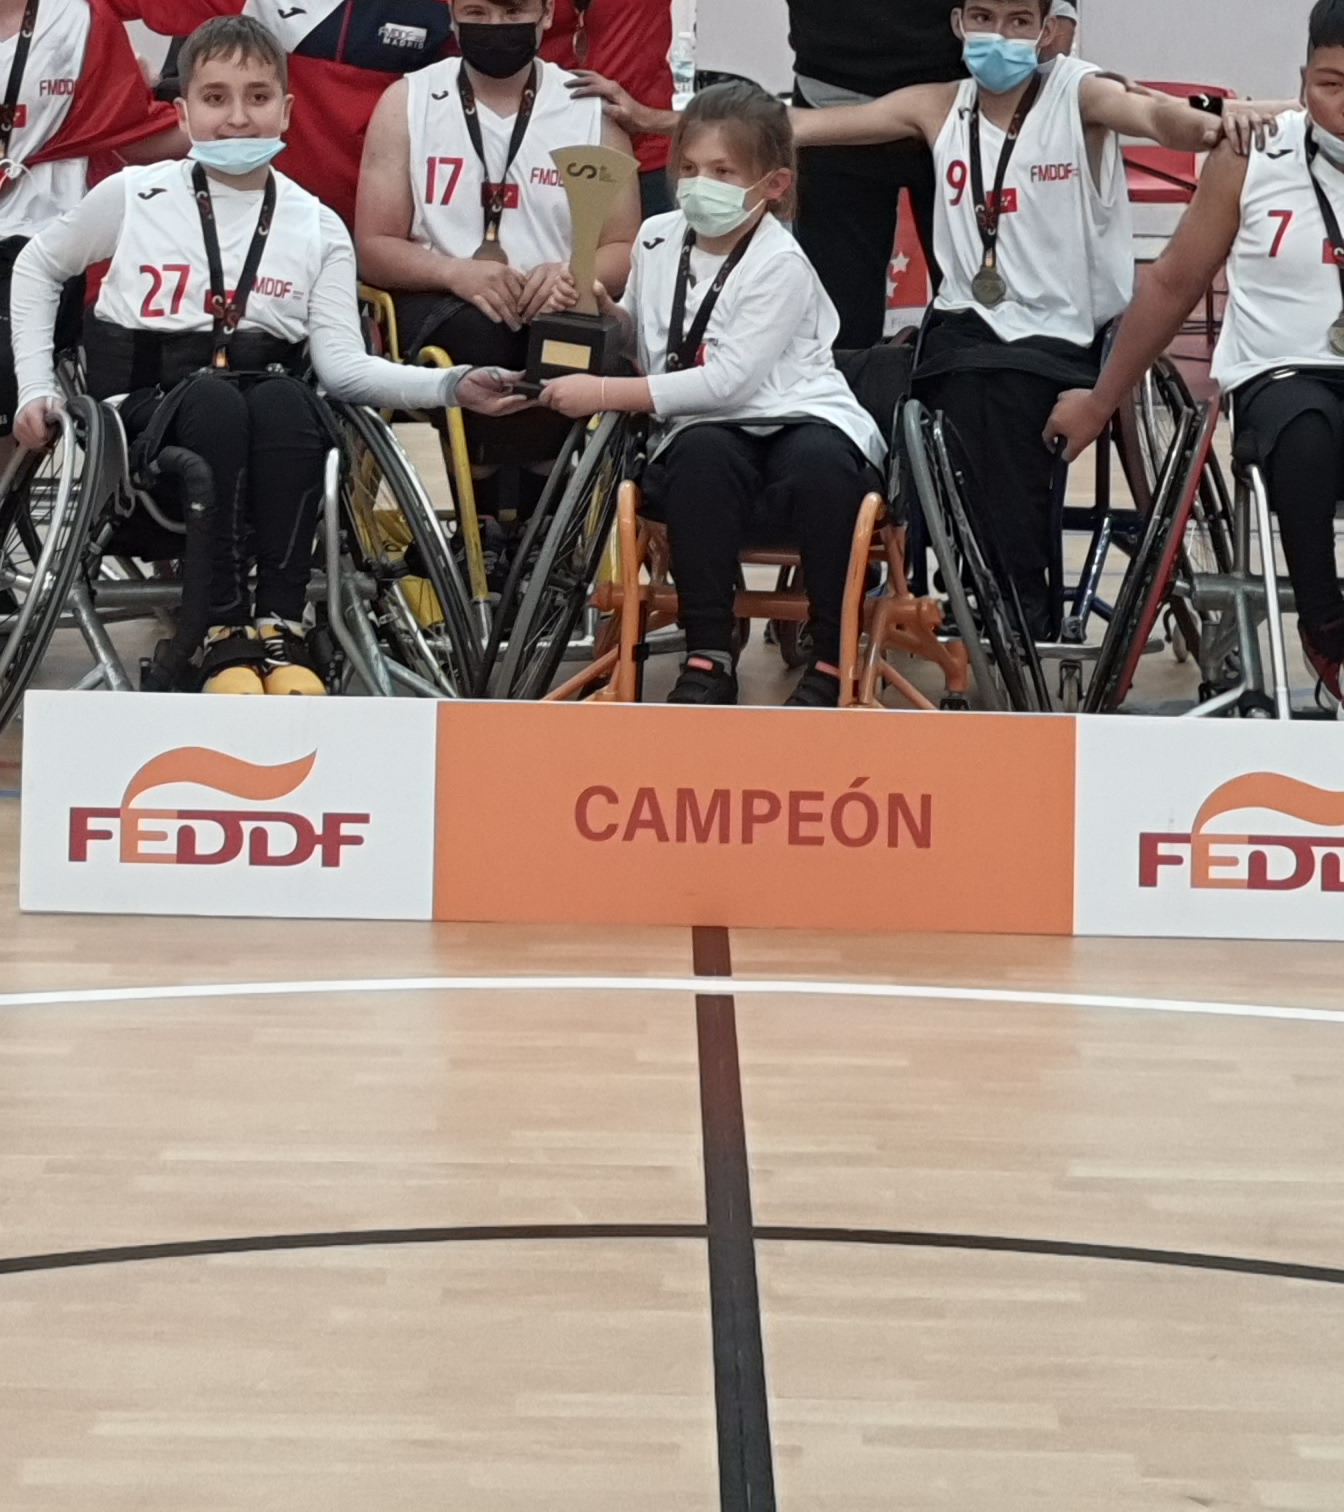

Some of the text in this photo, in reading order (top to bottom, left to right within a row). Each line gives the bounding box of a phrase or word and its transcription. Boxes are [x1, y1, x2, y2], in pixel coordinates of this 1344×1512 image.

[39, 78, 76, 97] FMDD
[425, 156, 464, 206] 17
[946, 159, 968, 206] 9
[1268, 209, 1294, 258] 7
[139, 263, 192, 318] 27
[253, 275, 293, 299] MDDF
[68, 806, 371, 868] FEDDF
[574, 776, 933, 849] CAMPEÓN
